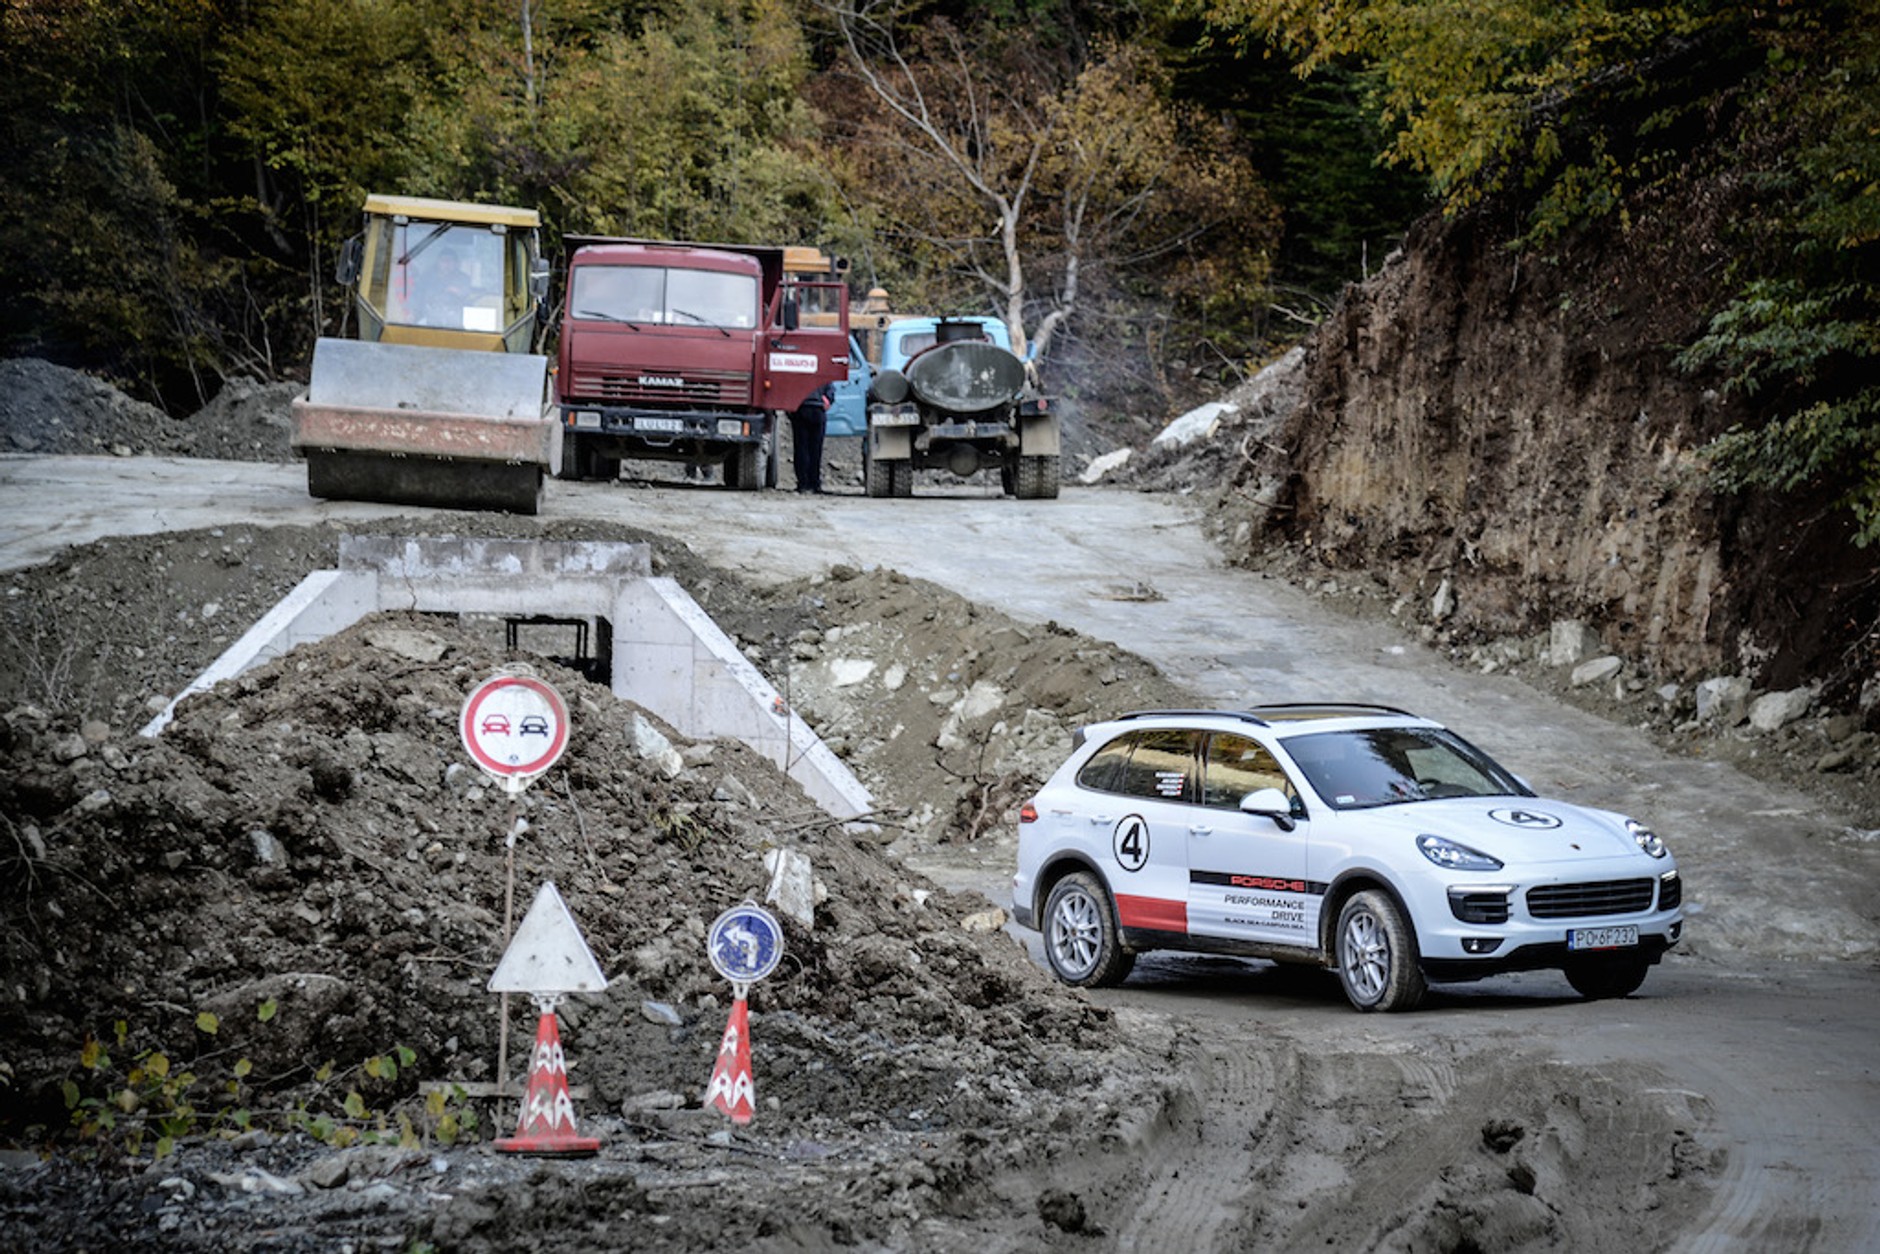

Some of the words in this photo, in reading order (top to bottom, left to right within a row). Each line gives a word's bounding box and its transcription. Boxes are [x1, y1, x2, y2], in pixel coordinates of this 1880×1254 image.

[638, 376, 684, 387] KAMAZ
[1511, 811, 1550, 825] 4
[1121, 822, 1142, 862] 4
[1231, 876, 1304, 891] PORSCHE
[1224, 895, 1304, 909] PERFORMANCE
[1272, 911, 1304, 922] DRIVE
